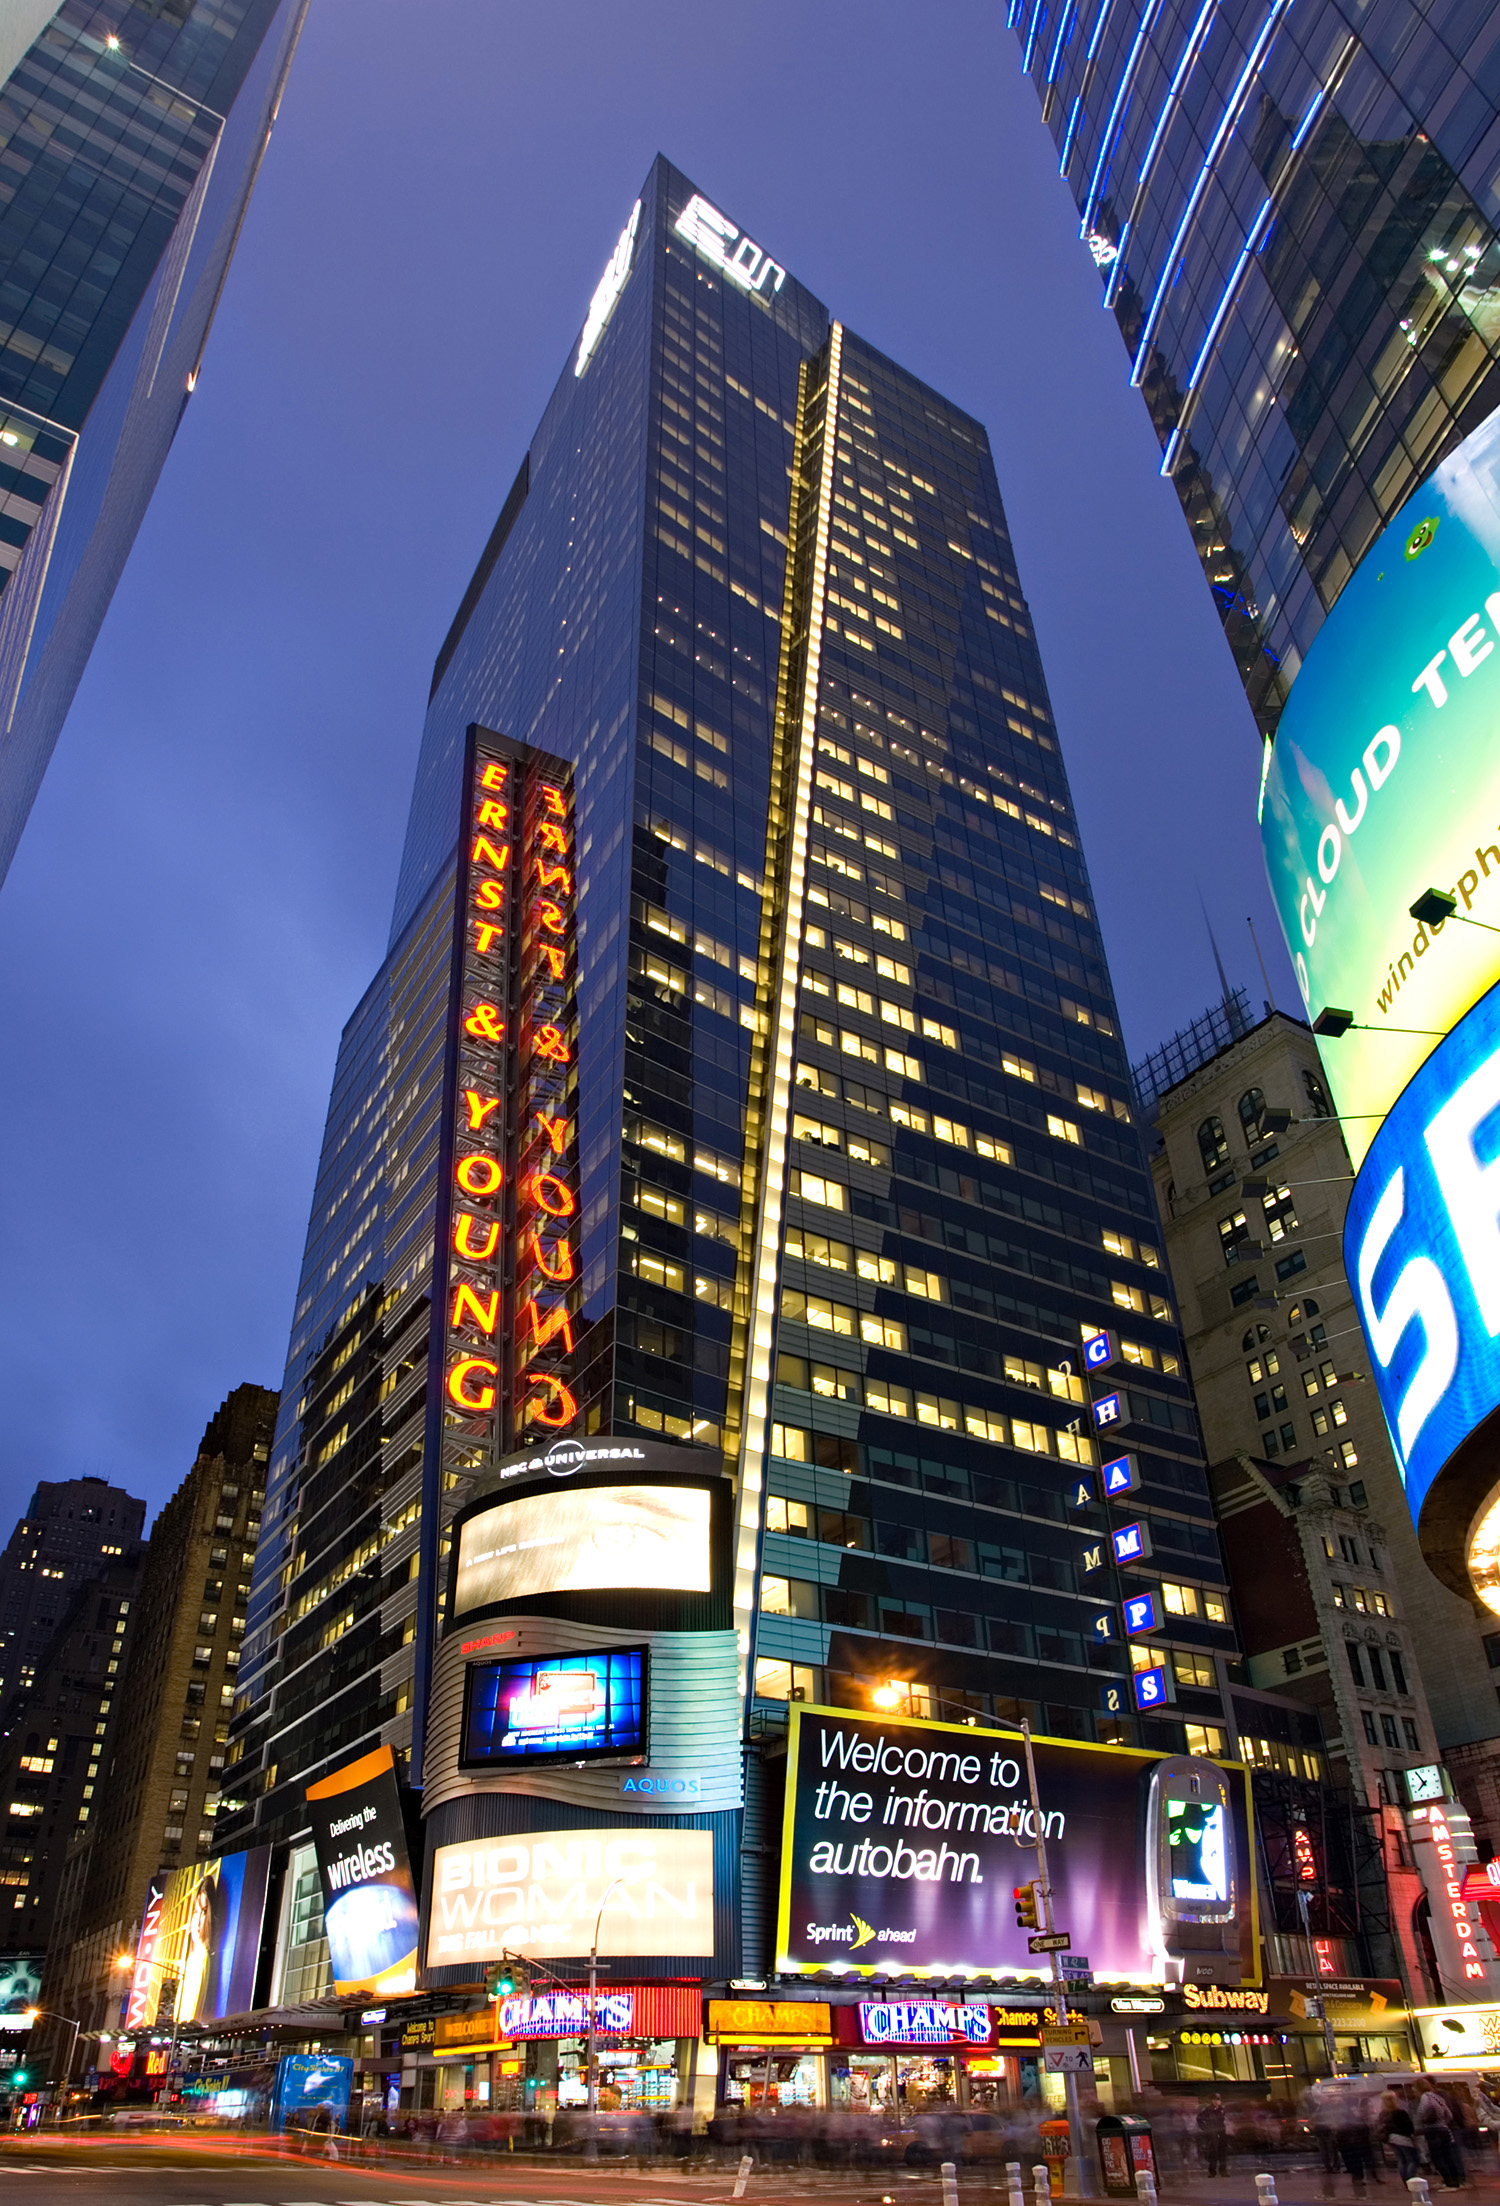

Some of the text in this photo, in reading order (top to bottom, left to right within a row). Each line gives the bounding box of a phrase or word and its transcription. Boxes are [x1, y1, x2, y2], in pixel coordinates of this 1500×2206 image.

[1301, 724, 1401, 948] CLOUD
[447, 763, 508, 1411] ERNST & YOUNG
[500, 1448, 645, 1479] NBC UNIVERSAL
[1088, 1339, 1158, 1702] CHAMPS
[460, 1630, 515, 1655] SHARP
[820, 1728, 1020, 1788] Welcome to
[623, 1777, 699, 1795] AQUOS
[329, 1805, 378, 1839] Delivering the
[815, 1780, 1065, 1840] the information
[326, 1840, 397, 1892] wireless
[439, 1838, 657, 1893] BIONIC
[809, 1837, 984, 1884] autobahn.
[440, 1880, 697, 1931] WOMAN
[1429, 1806, 1485, 1980] AMSTERDAM
[464, 1928, 499, 1950] FALL
[806, 1921, 917, 1946] Sprint ahead
[1053, 1938, 1065, 1946] WAY
[1070, 1981, 1077, 1991] 7
[1182, 1983, 1269, 2014] Subway
[1339, 1983, 1365, 1991] AVAILABLE
[406, 2019, 434, 2034] Welcome to
[499, 1992, 631, 2034] CHAMPS
[732, 2006, 811, 2028] CHAMPS
[867, 2006, 992, 2038] CHAMPS
[995, 2006, 1039, 2026] Champs
[402, 2033, 420, 2046] Champs
[146, 2050, 167, 2074] Red
